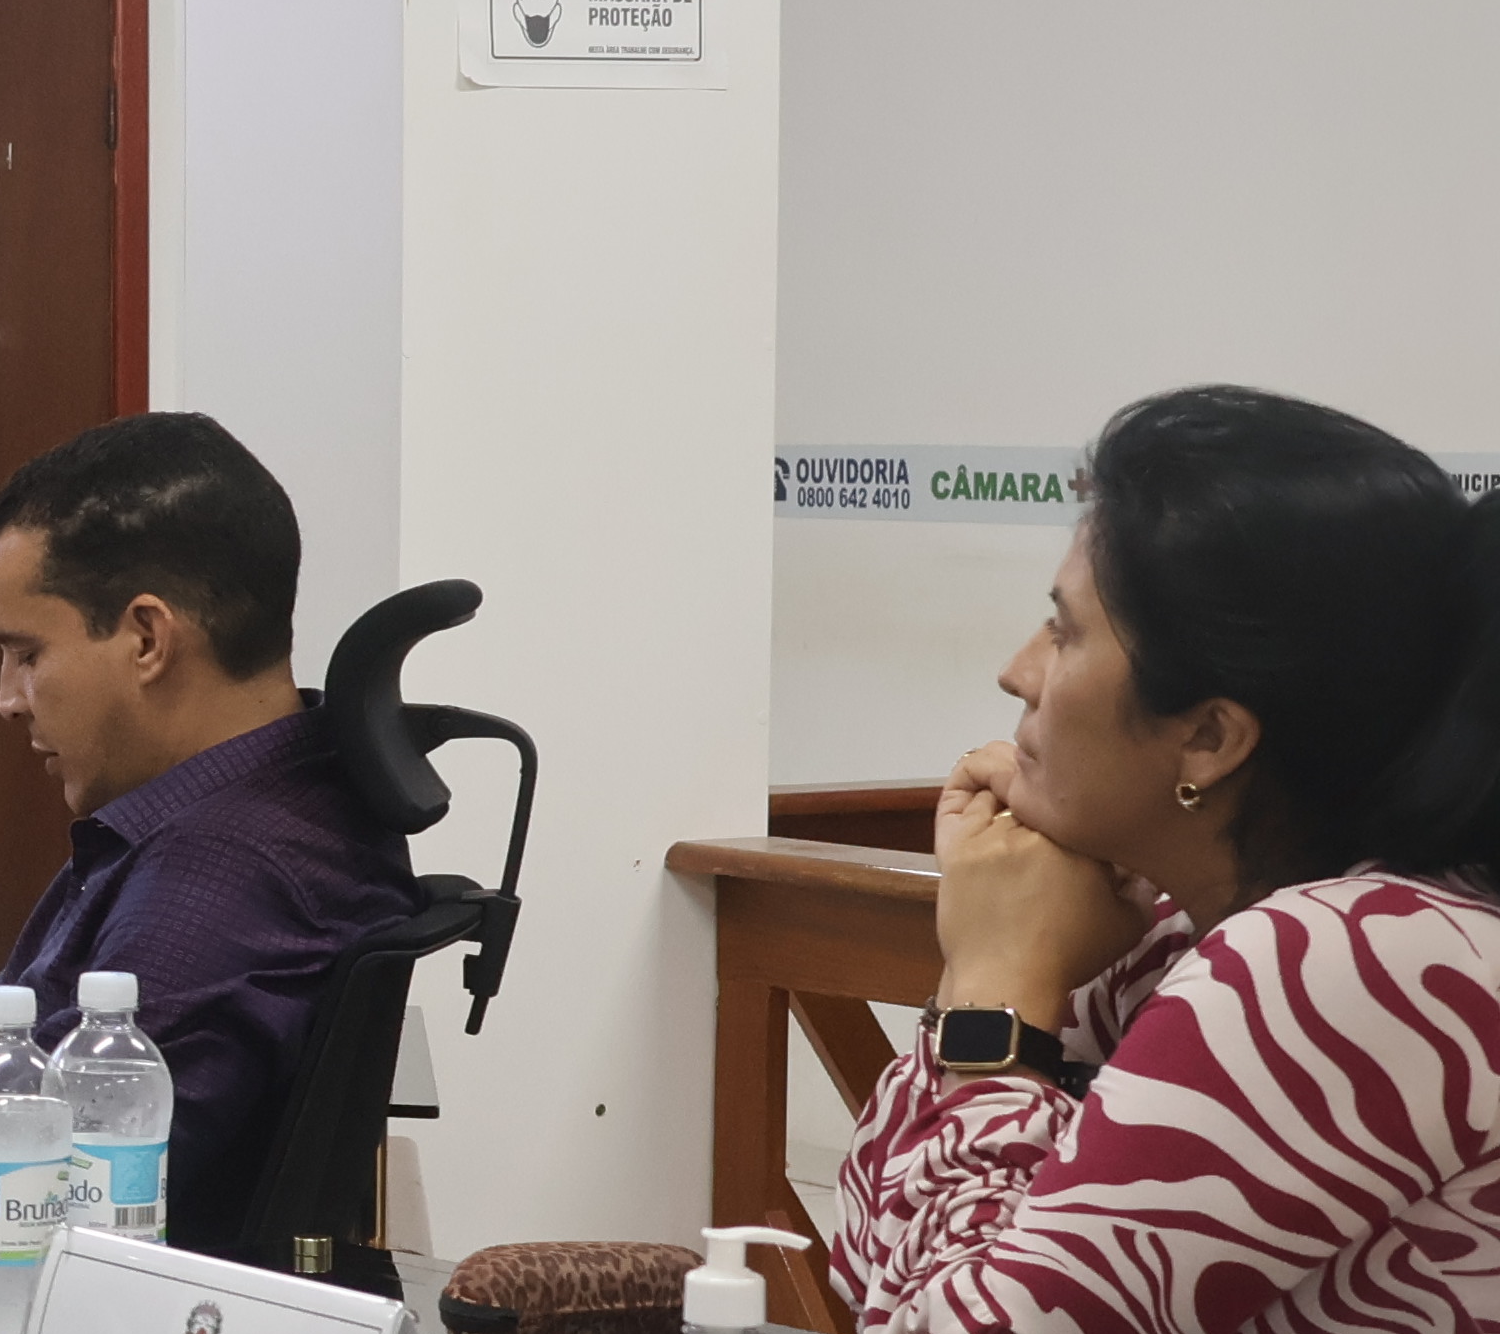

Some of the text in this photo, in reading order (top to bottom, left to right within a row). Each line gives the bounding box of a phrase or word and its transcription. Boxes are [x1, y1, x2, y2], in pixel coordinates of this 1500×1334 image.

[589, 4, 672, 32] PROTEÇÃO
[796, 458, 910, 485] OUVIDORIA
[797, 486, 911, 509] 0800 642 4010
